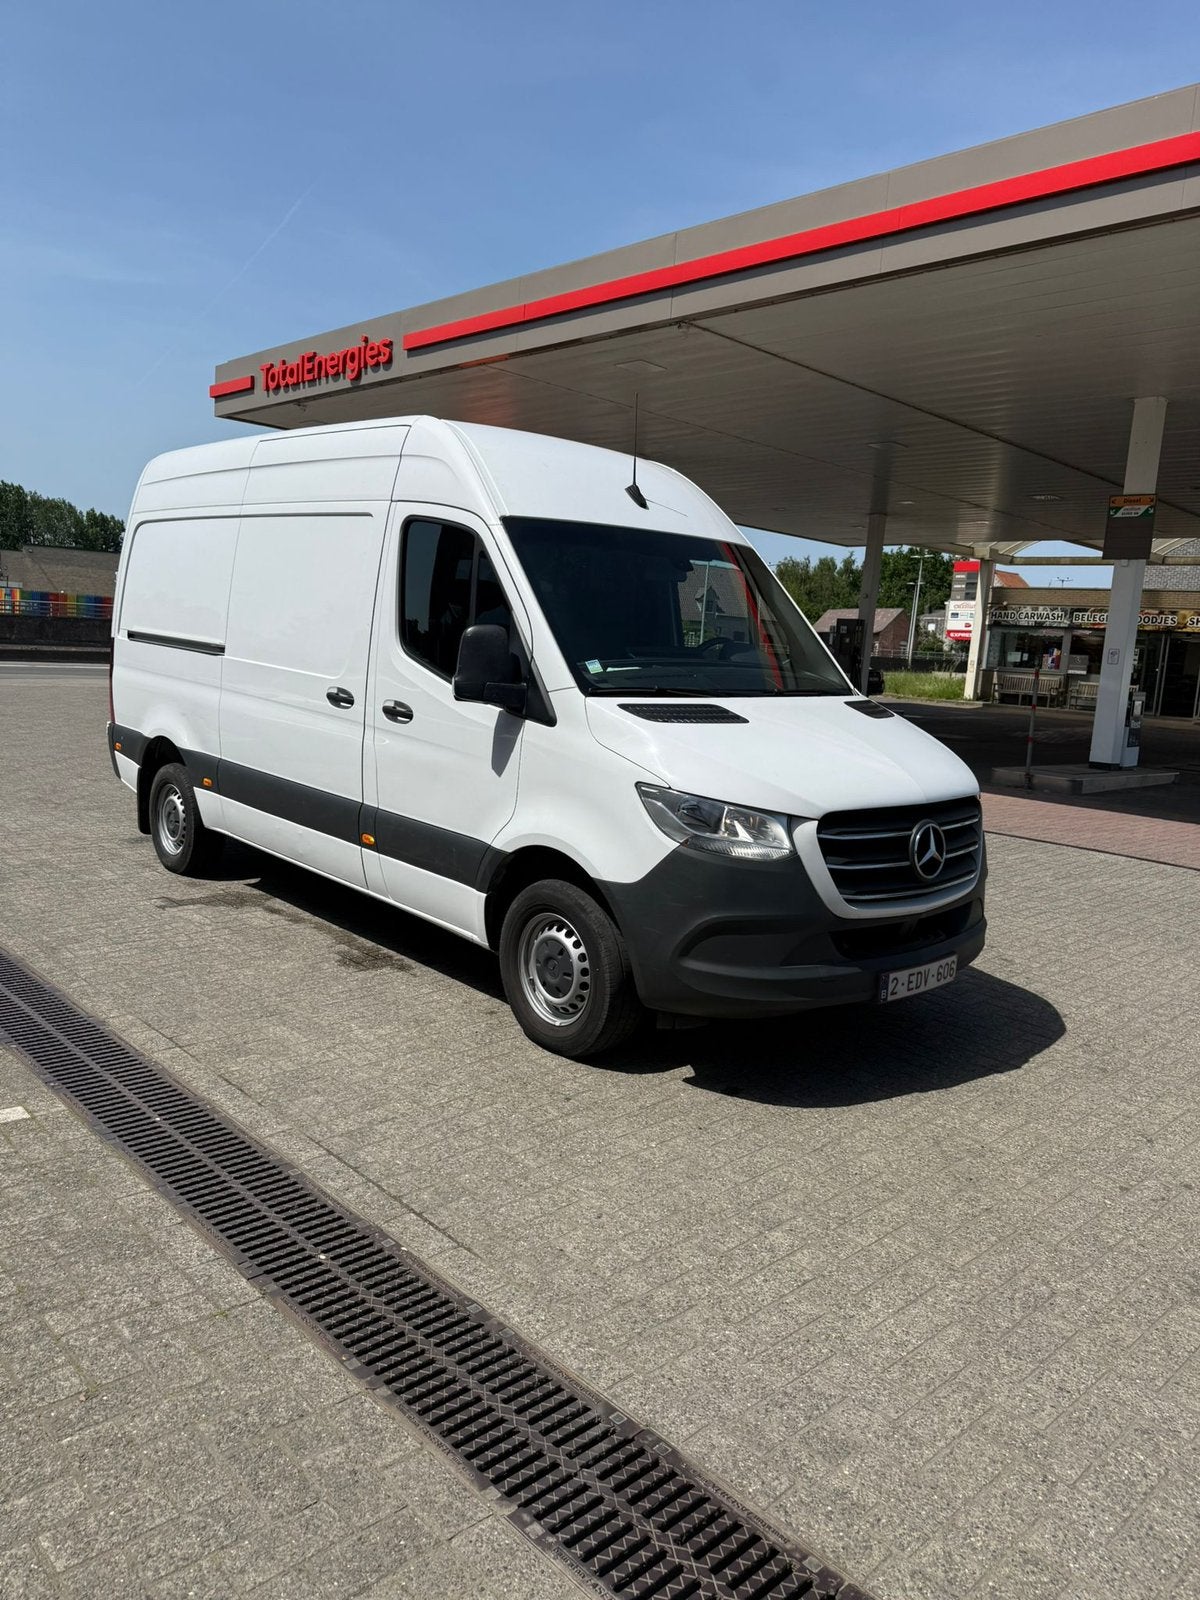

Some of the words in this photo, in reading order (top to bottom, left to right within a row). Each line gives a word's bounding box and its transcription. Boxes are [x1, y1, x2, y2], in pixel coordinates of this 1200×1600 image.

[260, 334, 393, 391] TotalEnergies
[990, 611, 1016, 620] HAND
[1019, 611, 1064, 621] CARWASH
